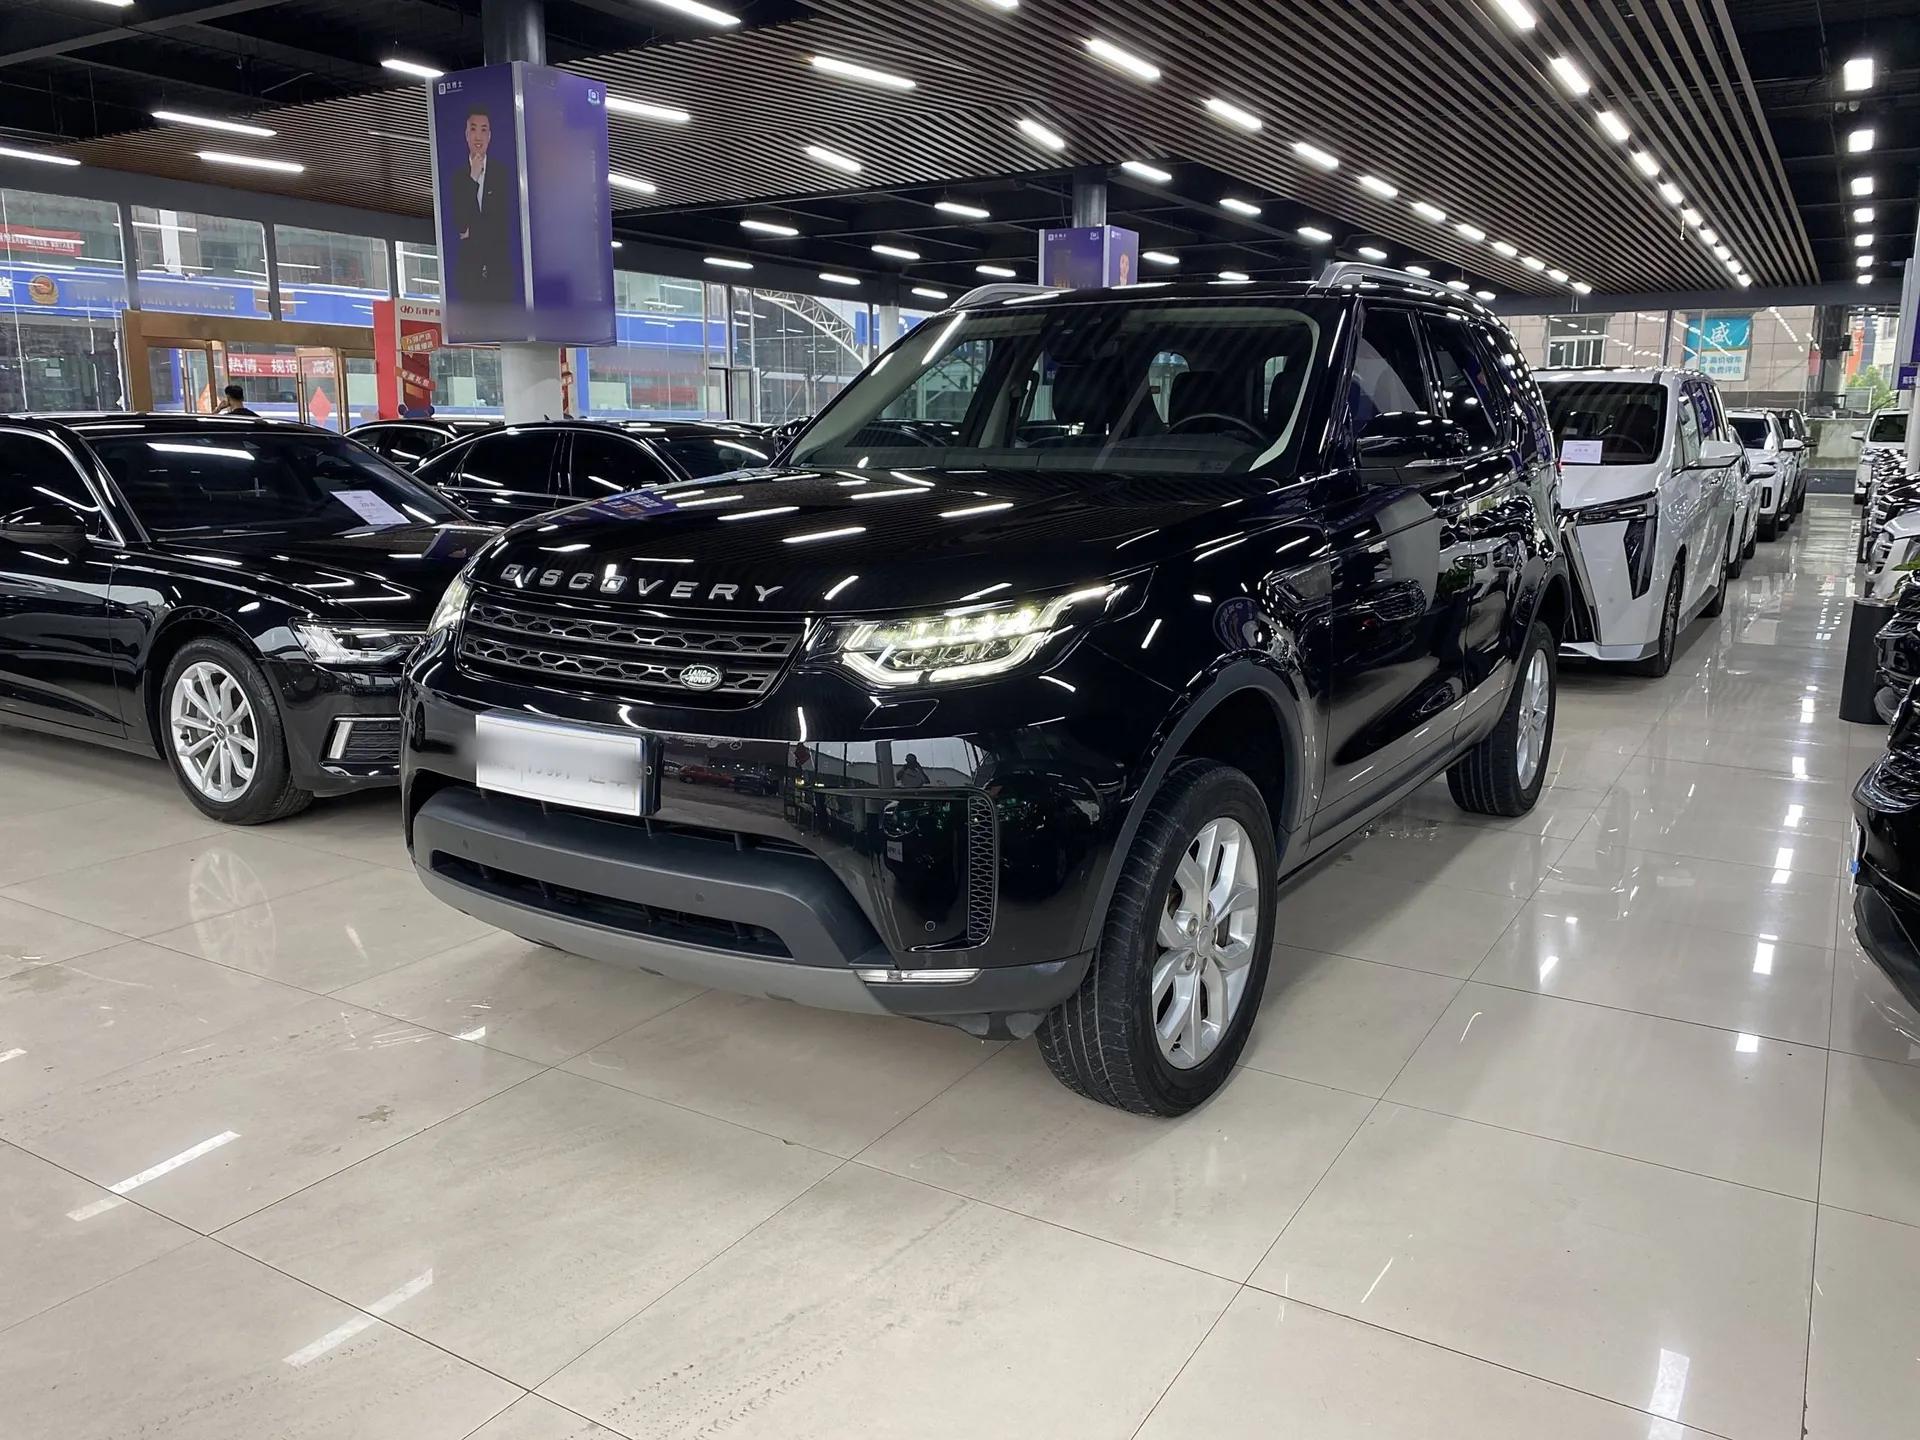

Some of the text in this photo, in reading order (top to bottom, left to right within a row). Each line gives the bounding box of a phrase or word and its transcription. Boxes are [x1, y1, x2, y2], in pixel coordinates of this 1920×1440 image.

[500, 563, 784, 602] DISCOVERY
[688, 669, 708, 677] LAND
[688, 676, 712, 684] ROVER
